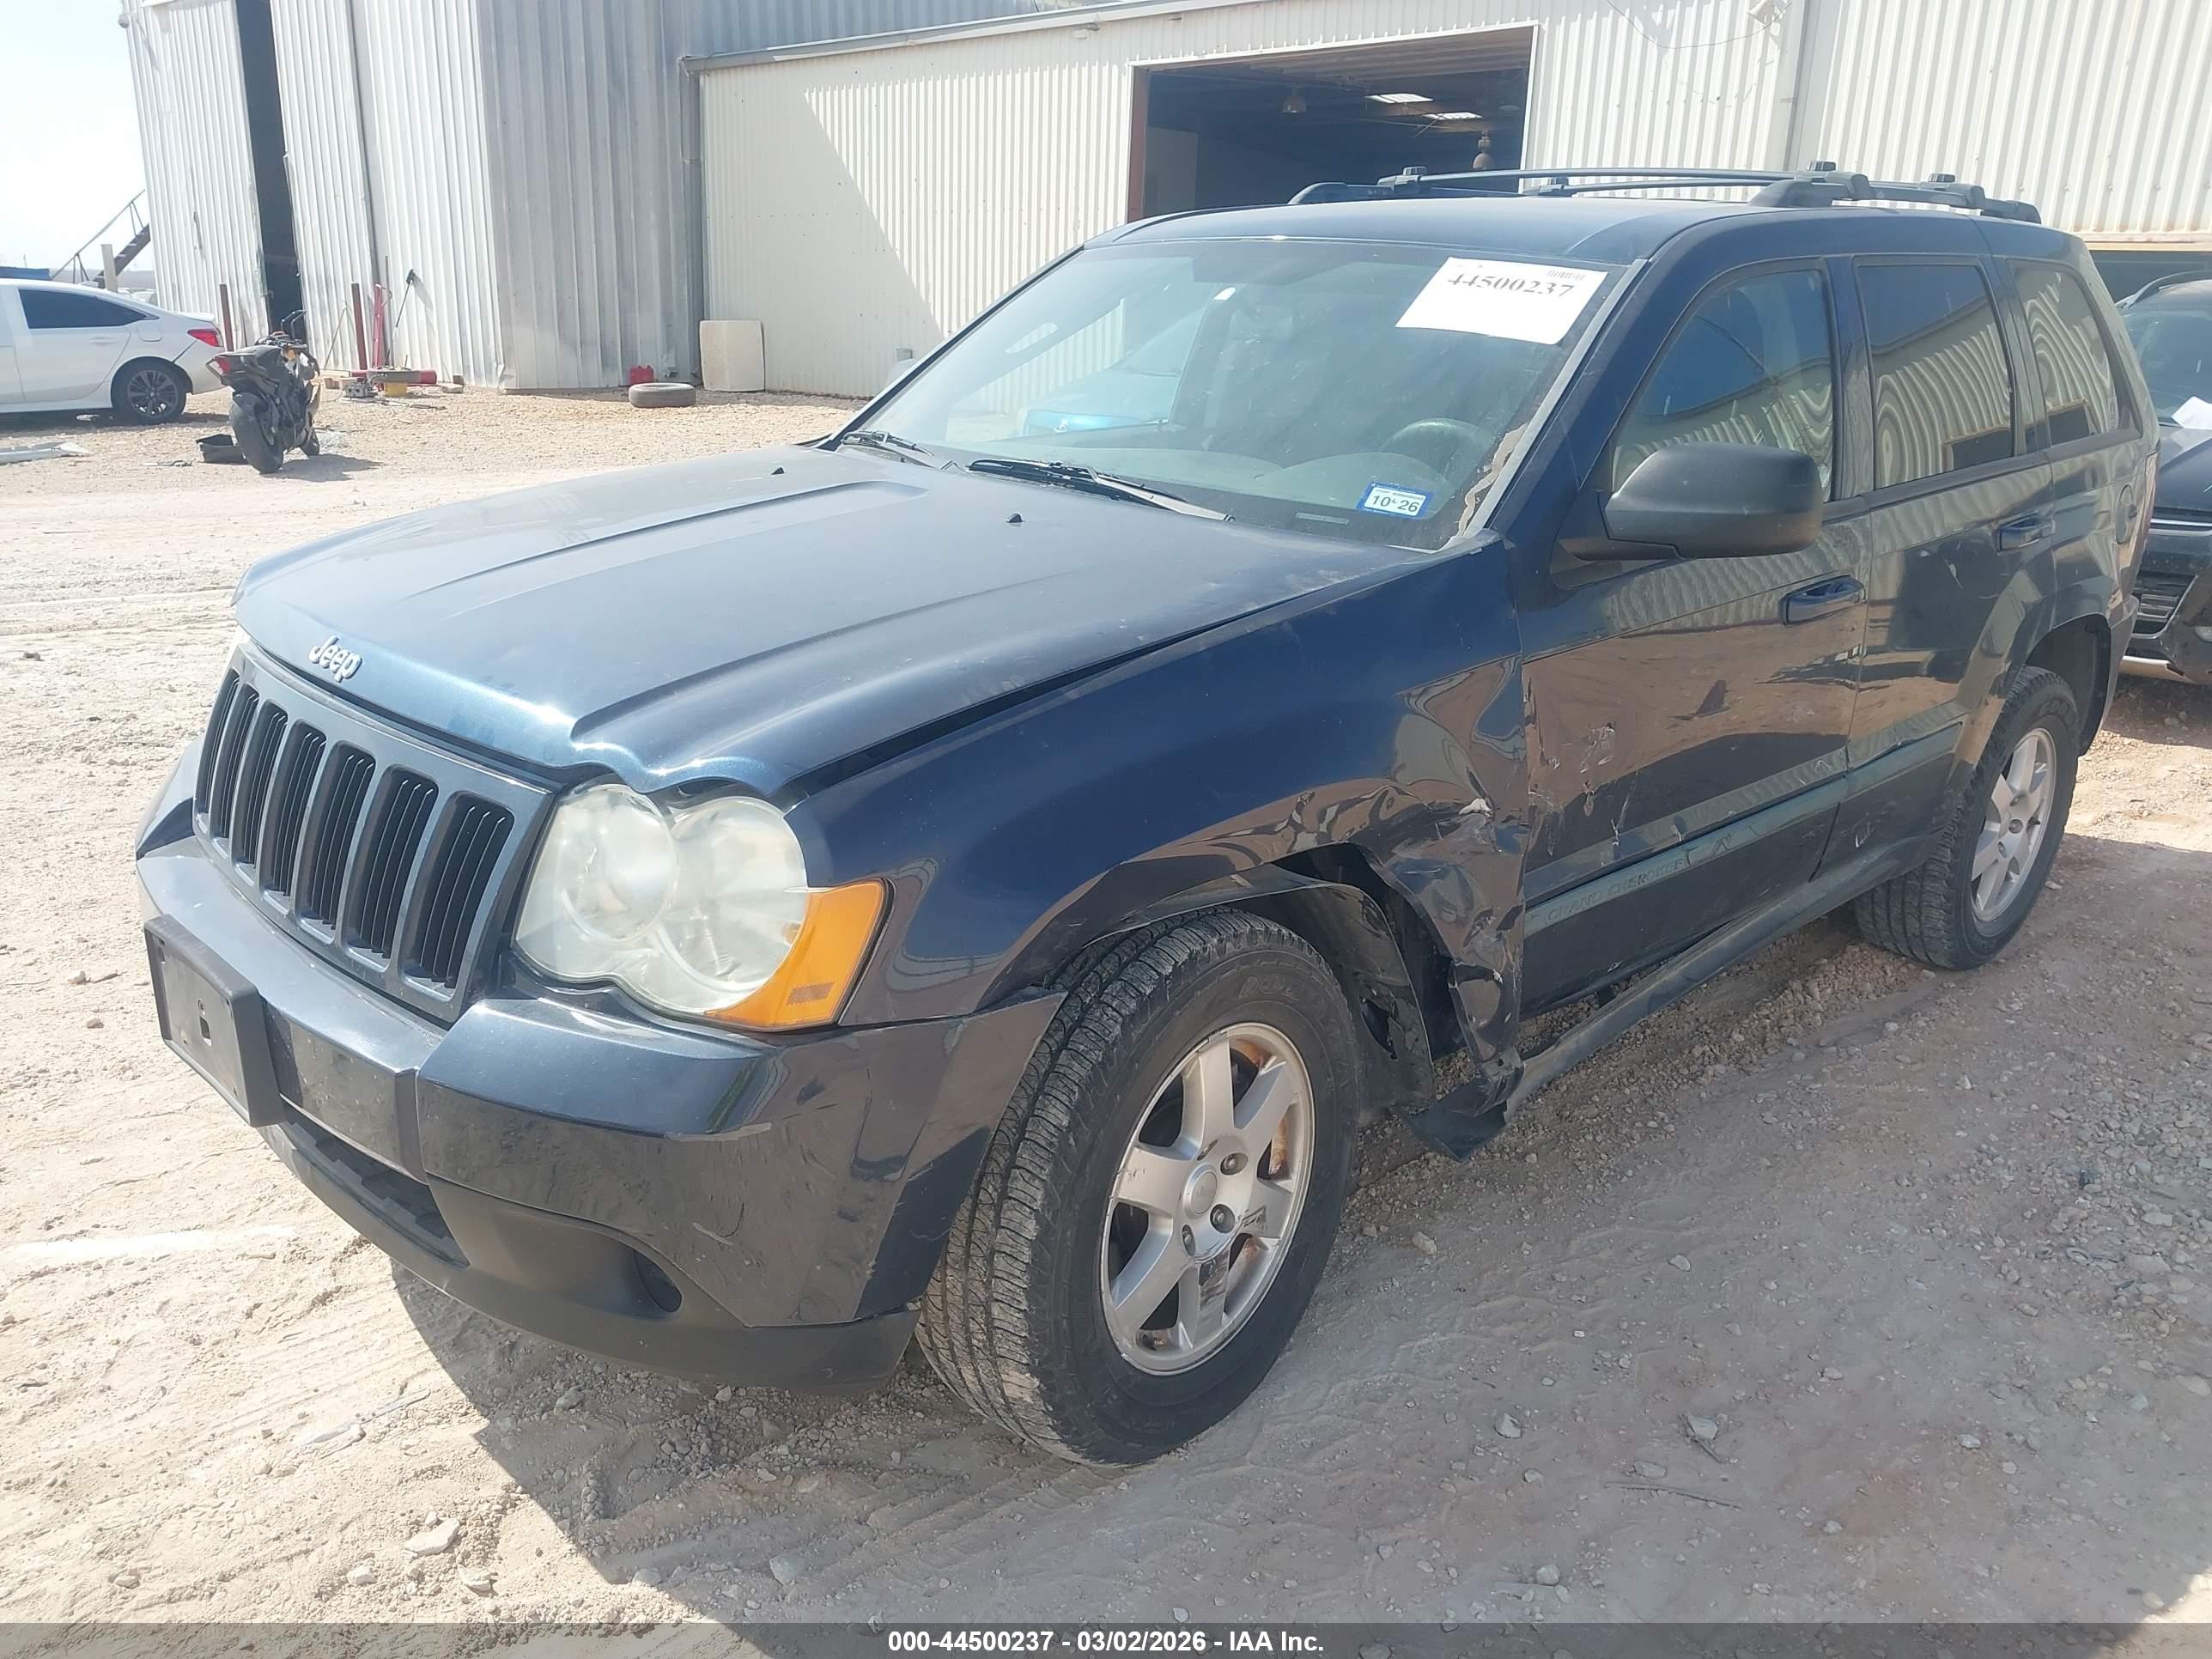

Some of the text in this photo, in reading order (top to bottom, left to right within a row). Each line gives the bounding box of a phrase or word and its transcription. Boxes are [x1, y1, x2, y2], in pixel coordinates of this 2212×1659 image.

[1448, 273, 1575, 297] 44500237
[1372, 495, 1392, 507] 10
[1397, 500, 1420, 513] 26
[309, 635, 363, 684] Jeep
[1548, 858, 1686, 921] GRAND CHEROKEE
